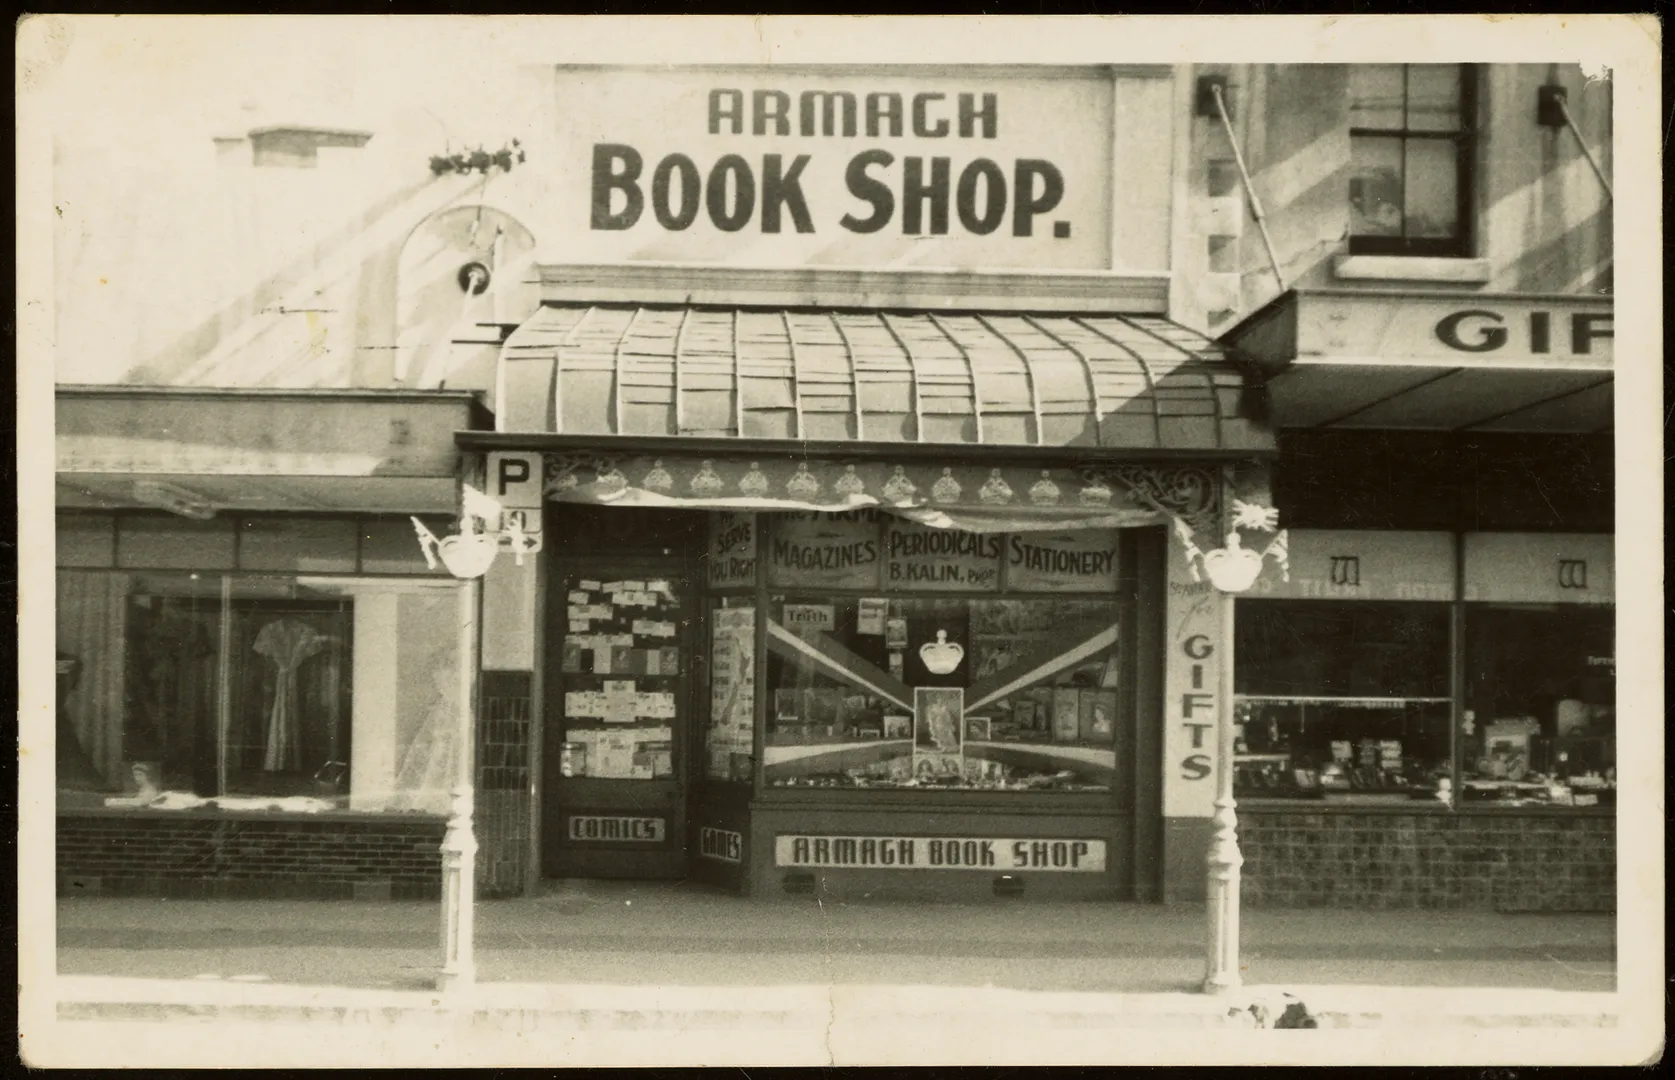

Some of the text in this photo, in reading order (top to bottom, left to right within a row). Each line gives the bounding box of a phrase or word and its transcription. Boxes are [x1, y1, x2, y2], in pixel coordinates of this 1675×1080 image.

[707, 87, 997, 138] ARMAGH
[590, 143, 1071, 238] BOOK SHOP.
[499, 458, 530, 496] P
[717, 522, 752, 554] SERVE
[773, 538, 877, 570] MAGAZINES
[890, 529, 999, 560] PERIODICALS
[1009, 535, 1116, 576] STATIONERY
[1180, 633, 1215, 782] GIFTS
[572, 817, 657, 839] COMICS
[792, 837, 1088, 868] ARMAGH BOOK SHOP
